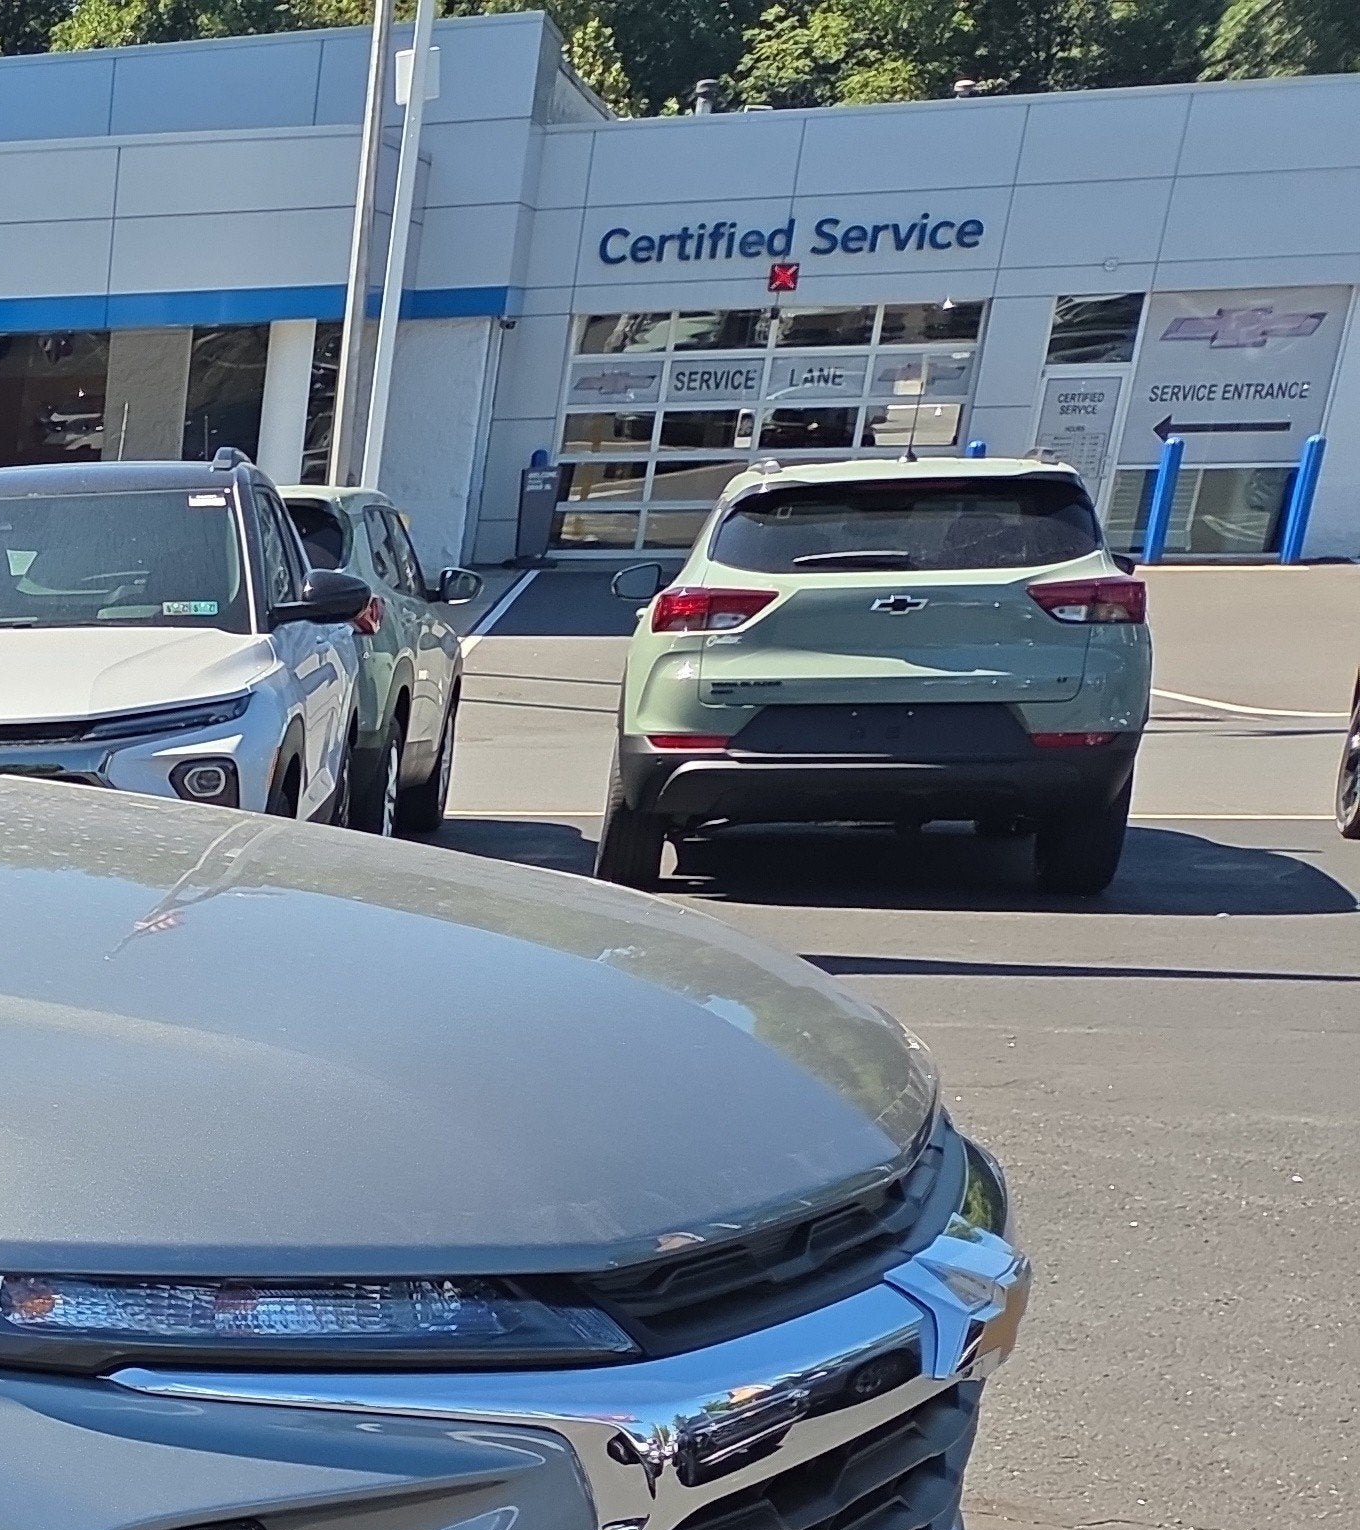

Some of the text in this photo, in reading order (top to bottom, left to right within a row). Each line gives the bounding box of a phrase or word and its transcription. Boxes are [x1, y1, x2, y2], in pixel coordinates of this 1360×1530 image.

[598, 212, 985, 265] Certified Service
[673, 365, 844, 392] SERVICE LANE
[1057, 392, 1105, 404] CERTIFIED
[1148, 381, 1311, 402] SERVICE ENTRANCE
[1059, 404, 1098, 415] SERVICE
